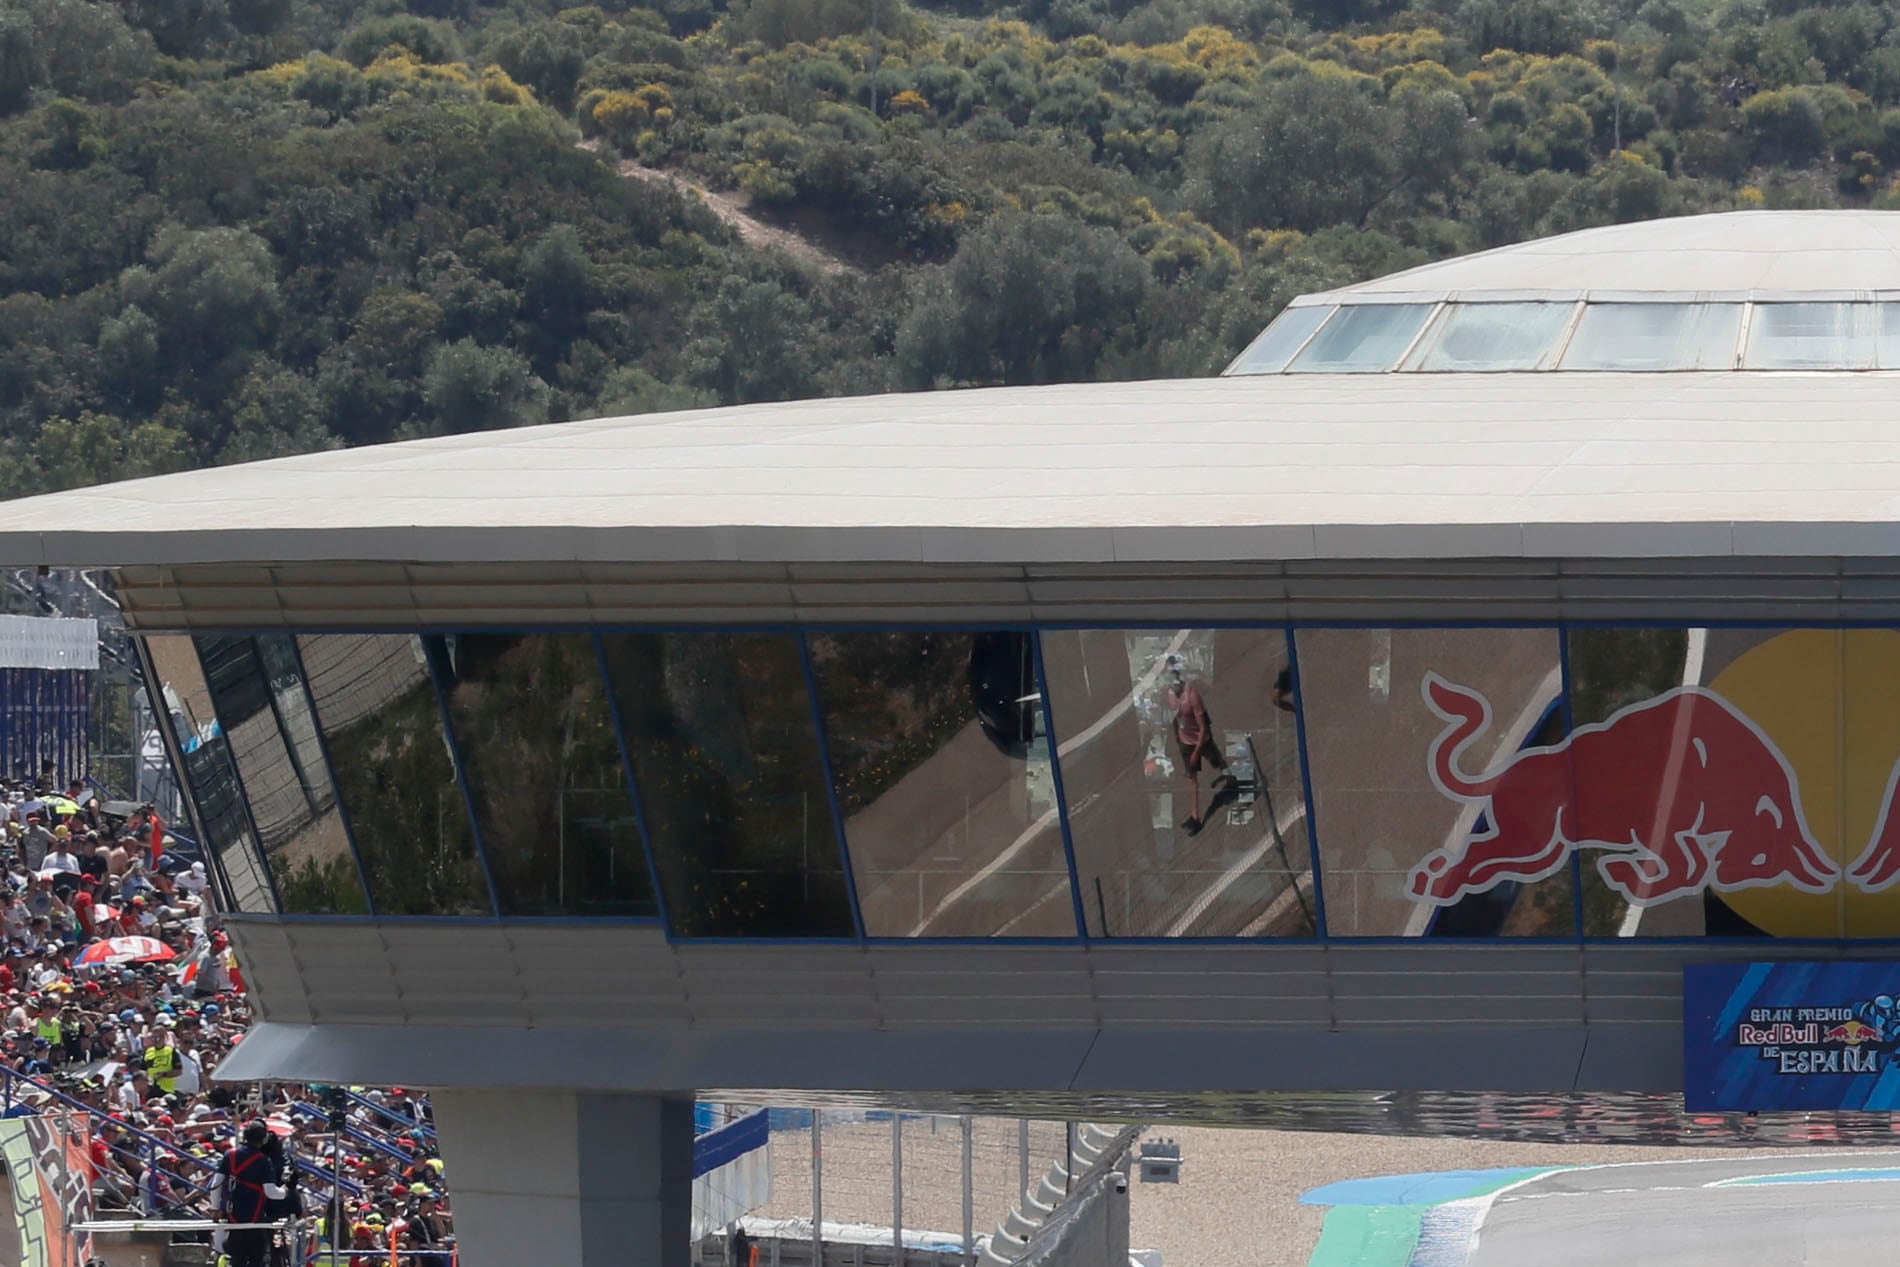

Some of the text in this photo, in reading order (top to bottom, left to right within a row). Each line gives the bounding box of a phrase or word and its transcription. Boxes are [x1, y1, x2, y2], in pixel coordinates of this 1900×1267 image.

[1750, 1008, 1853, 1022] GRAN PREMIO
[1739, 1023, 1818, 1045] Red Bull
[1763, 1046, 1780, 1058] DE
[1779, 1045, 1880, 1073] ESPAÑA
